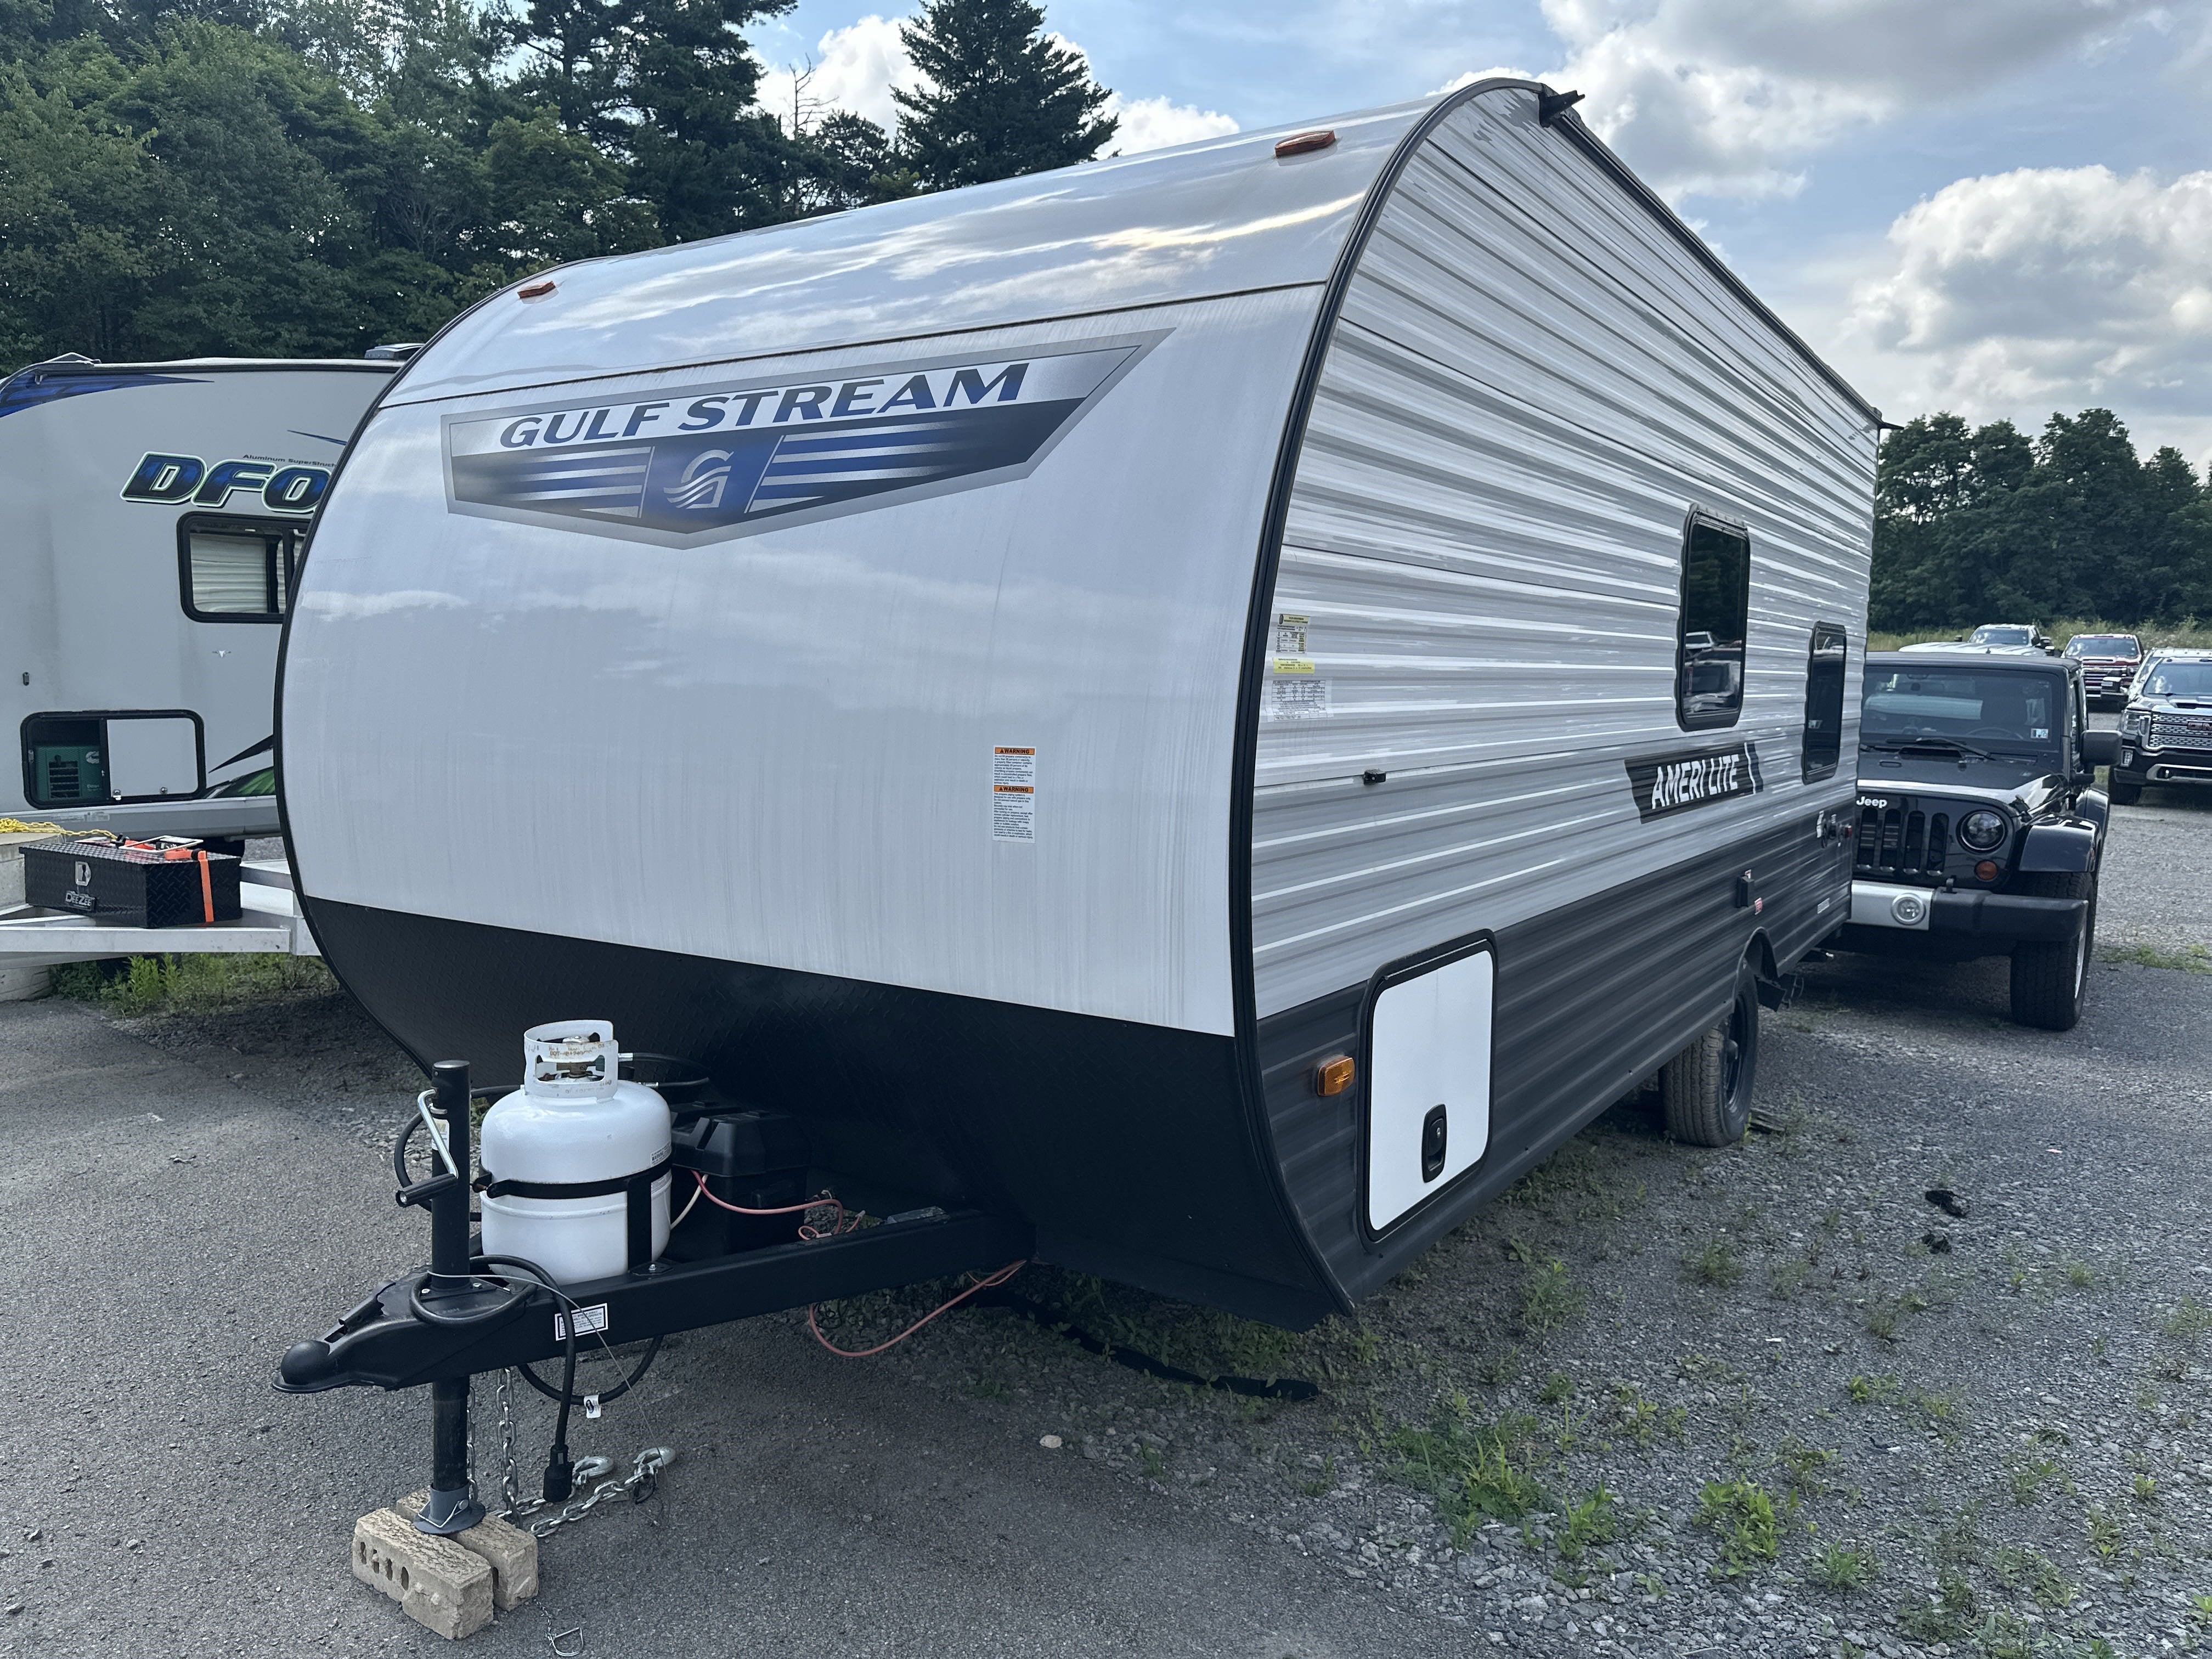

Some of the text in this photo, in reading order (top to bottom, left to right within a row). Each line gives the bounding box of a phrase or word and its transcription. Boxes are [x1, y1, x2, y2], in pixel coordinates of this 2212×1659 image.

[500, 363, 1029, 448] GULF STREAM
[242, 454, 336, 467] Aluminum SuperStruct
[1651, 754, 1739, 809] AMERI LITE
[1857, 796, 1887, 809] Jeep
